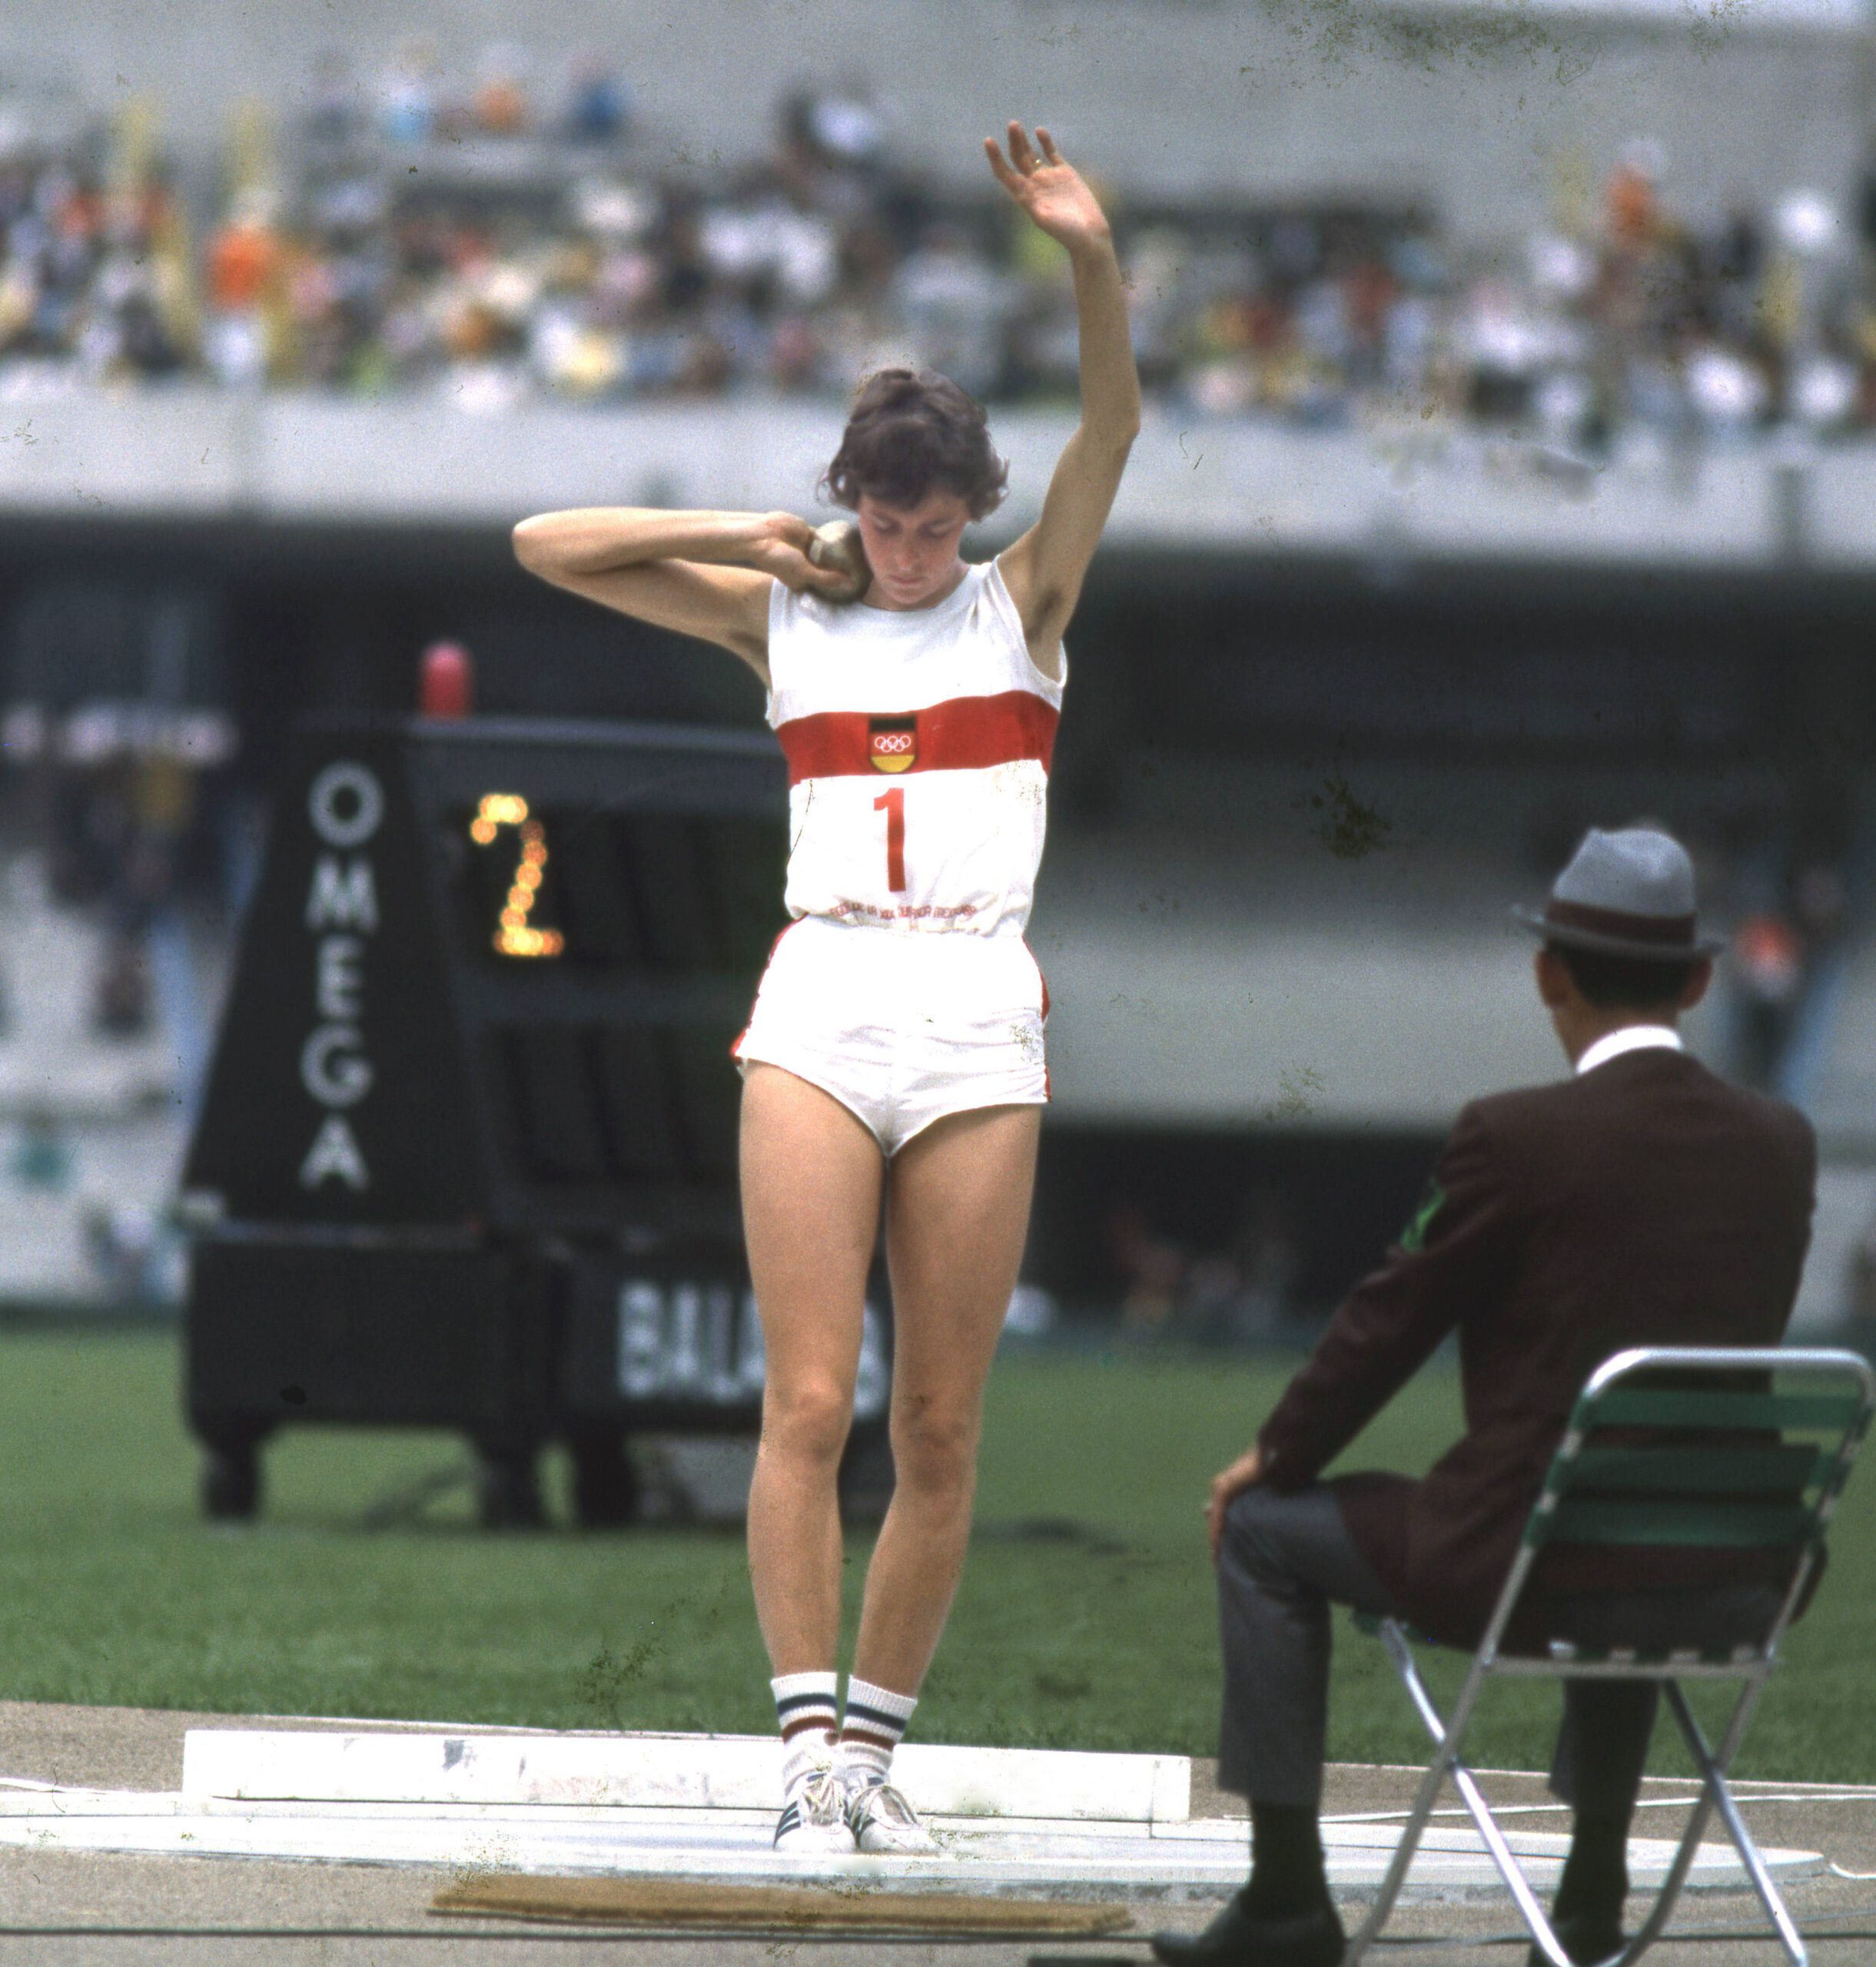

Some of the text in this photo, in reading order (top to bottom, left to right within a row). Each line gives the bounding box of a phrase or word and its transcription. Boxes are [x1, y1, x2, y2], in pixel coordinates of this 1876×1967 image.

[470, 794, 564, 956] 2
[874, 788, 906, 892] 1
[300, 761, 383, 1190] OMEGA
